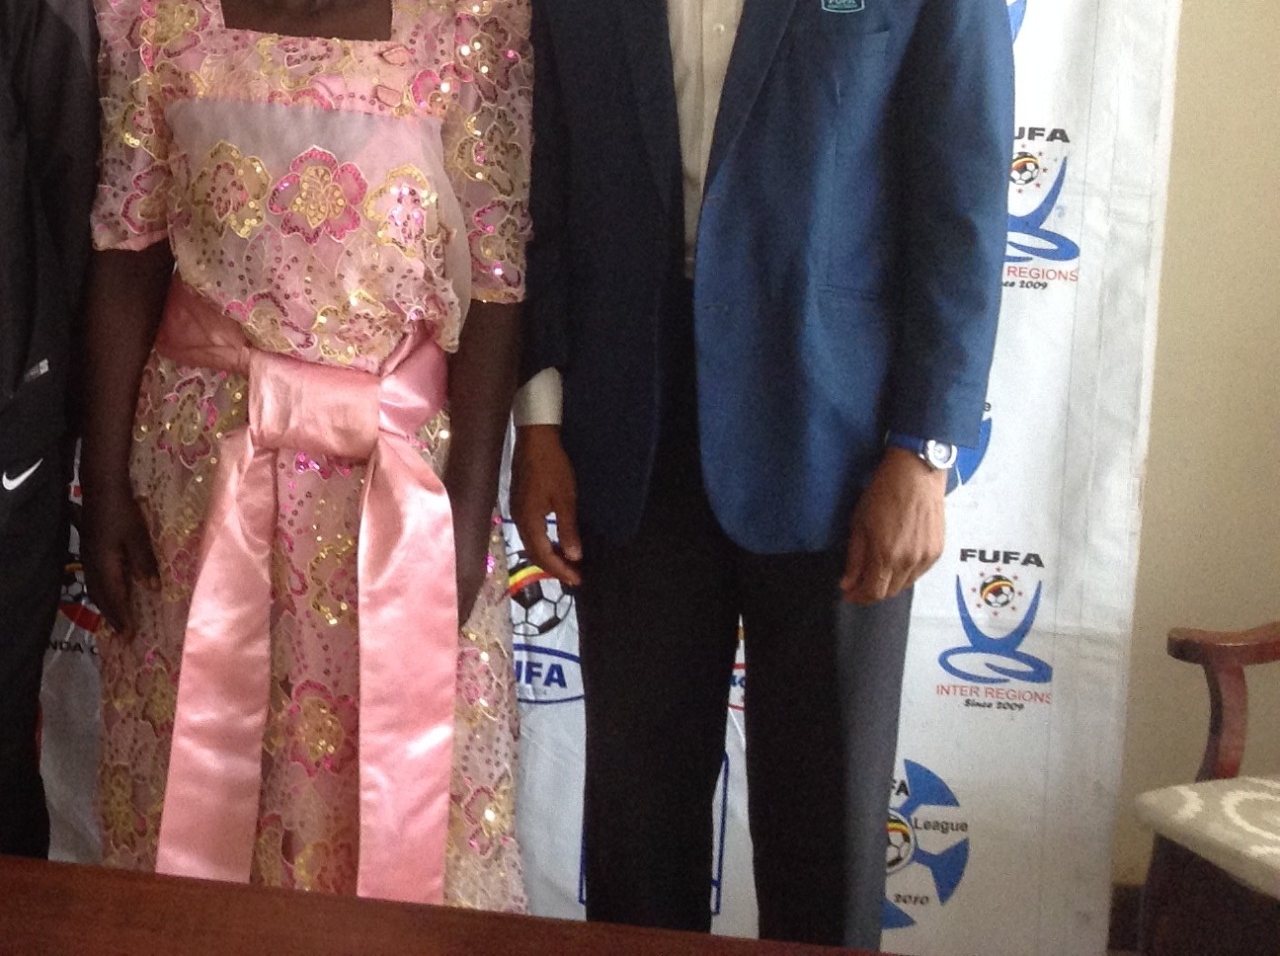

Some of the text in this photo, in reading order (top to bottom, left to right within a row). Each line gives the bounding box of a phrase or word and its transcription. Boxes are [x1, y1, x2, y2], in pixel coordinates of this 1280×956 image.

[1007, 265, 1079, 282] REGIONS
[1019, 280, 1048, 290] 2009
[960, 548, 1045, 568] FUFA
[937, 685, 1052, 704] INTER REGIONS
[964, 698, 1024, 711] Since 2009
[914, 817, 968, 833] League
